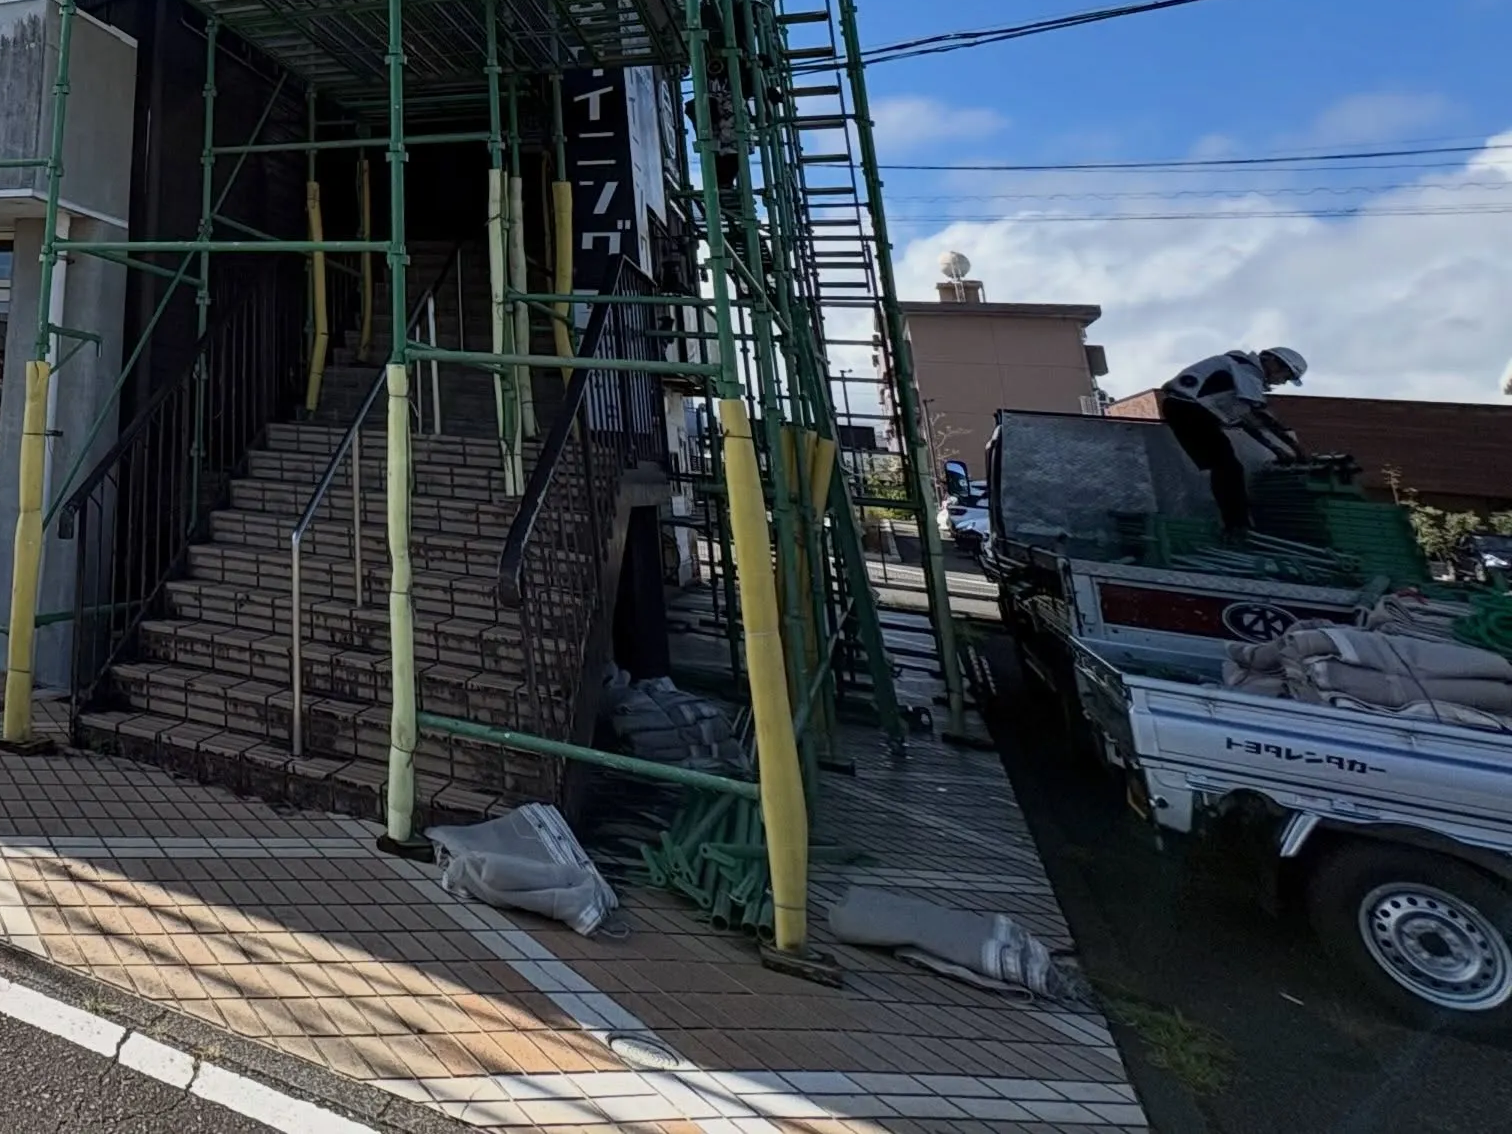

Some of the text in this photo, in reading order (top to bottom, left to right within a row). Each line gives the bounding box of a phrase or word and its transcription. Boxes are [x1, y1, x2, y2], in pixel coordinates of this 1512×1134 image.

[1226, 737, 1386, 773] トヨタレンタカー
